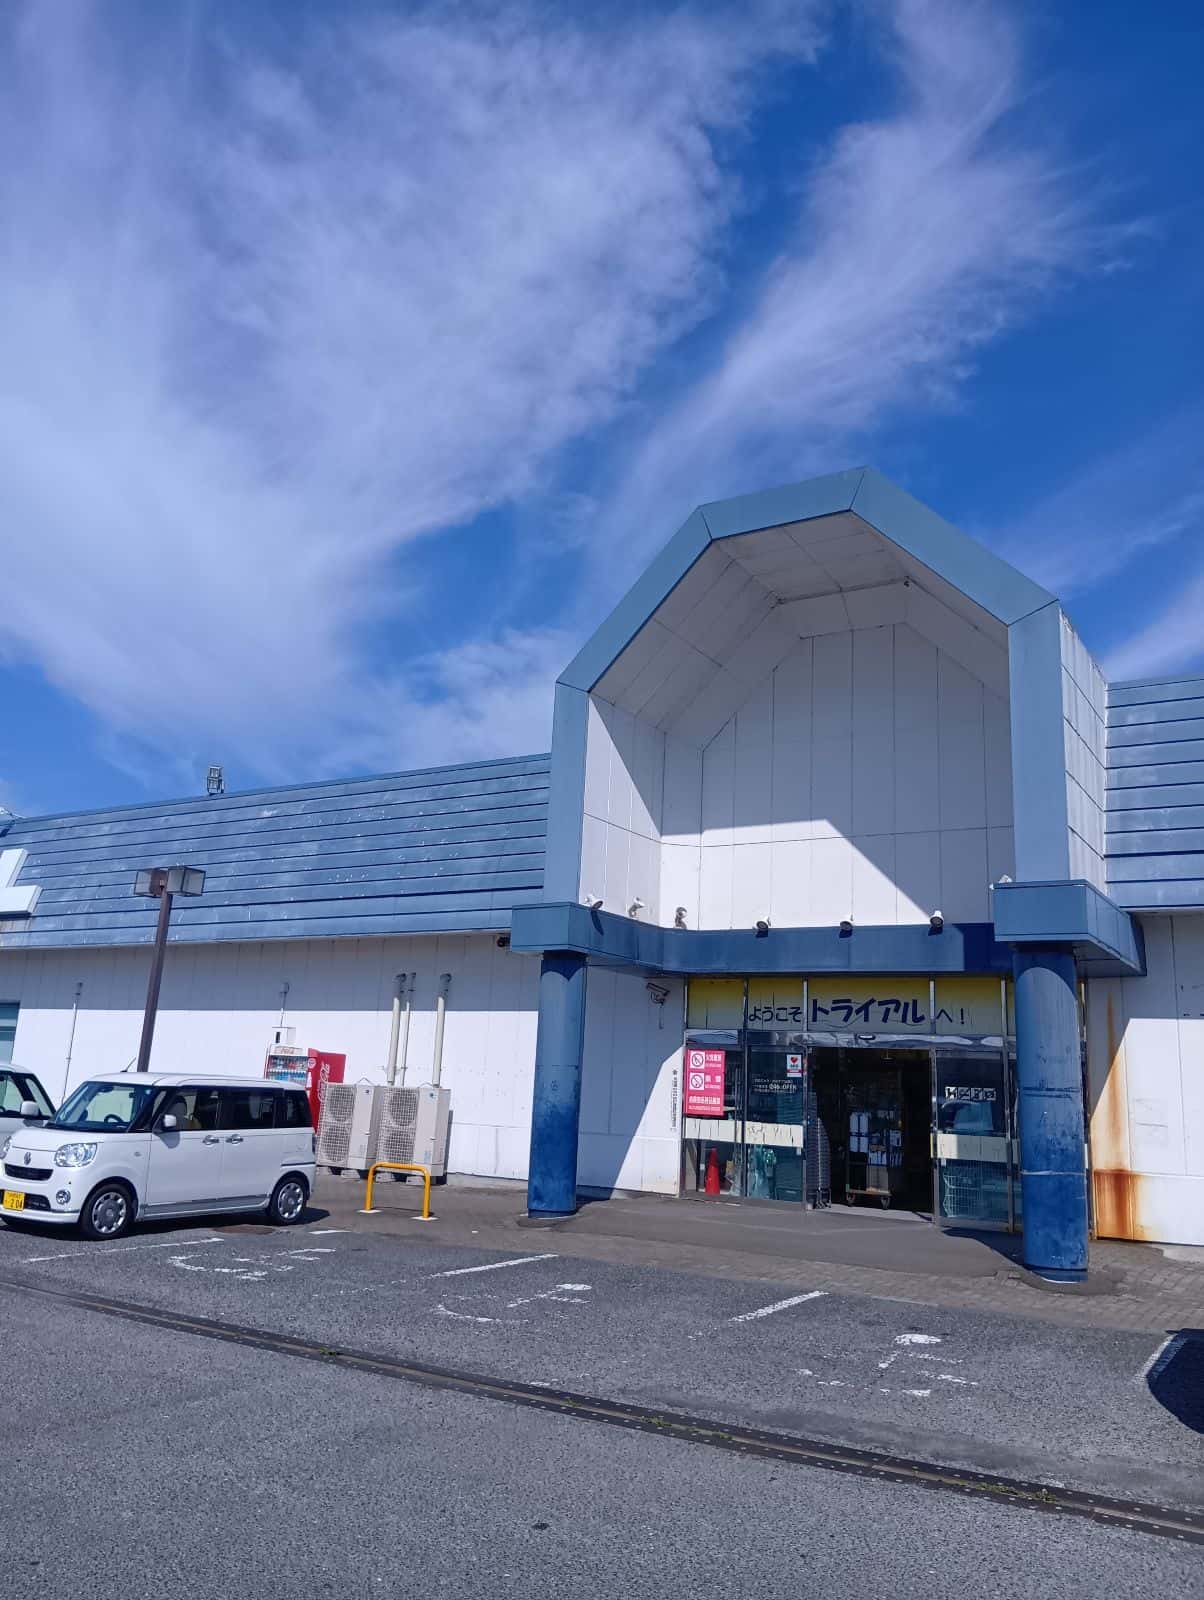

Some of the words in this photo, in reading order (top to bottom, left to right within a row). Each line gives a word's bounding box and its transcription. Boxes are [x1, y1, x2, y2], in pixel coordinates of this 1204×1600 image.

[749, 1007, 802, 1022] ようこそ
[811, 998, 926, 1023] トライアル
